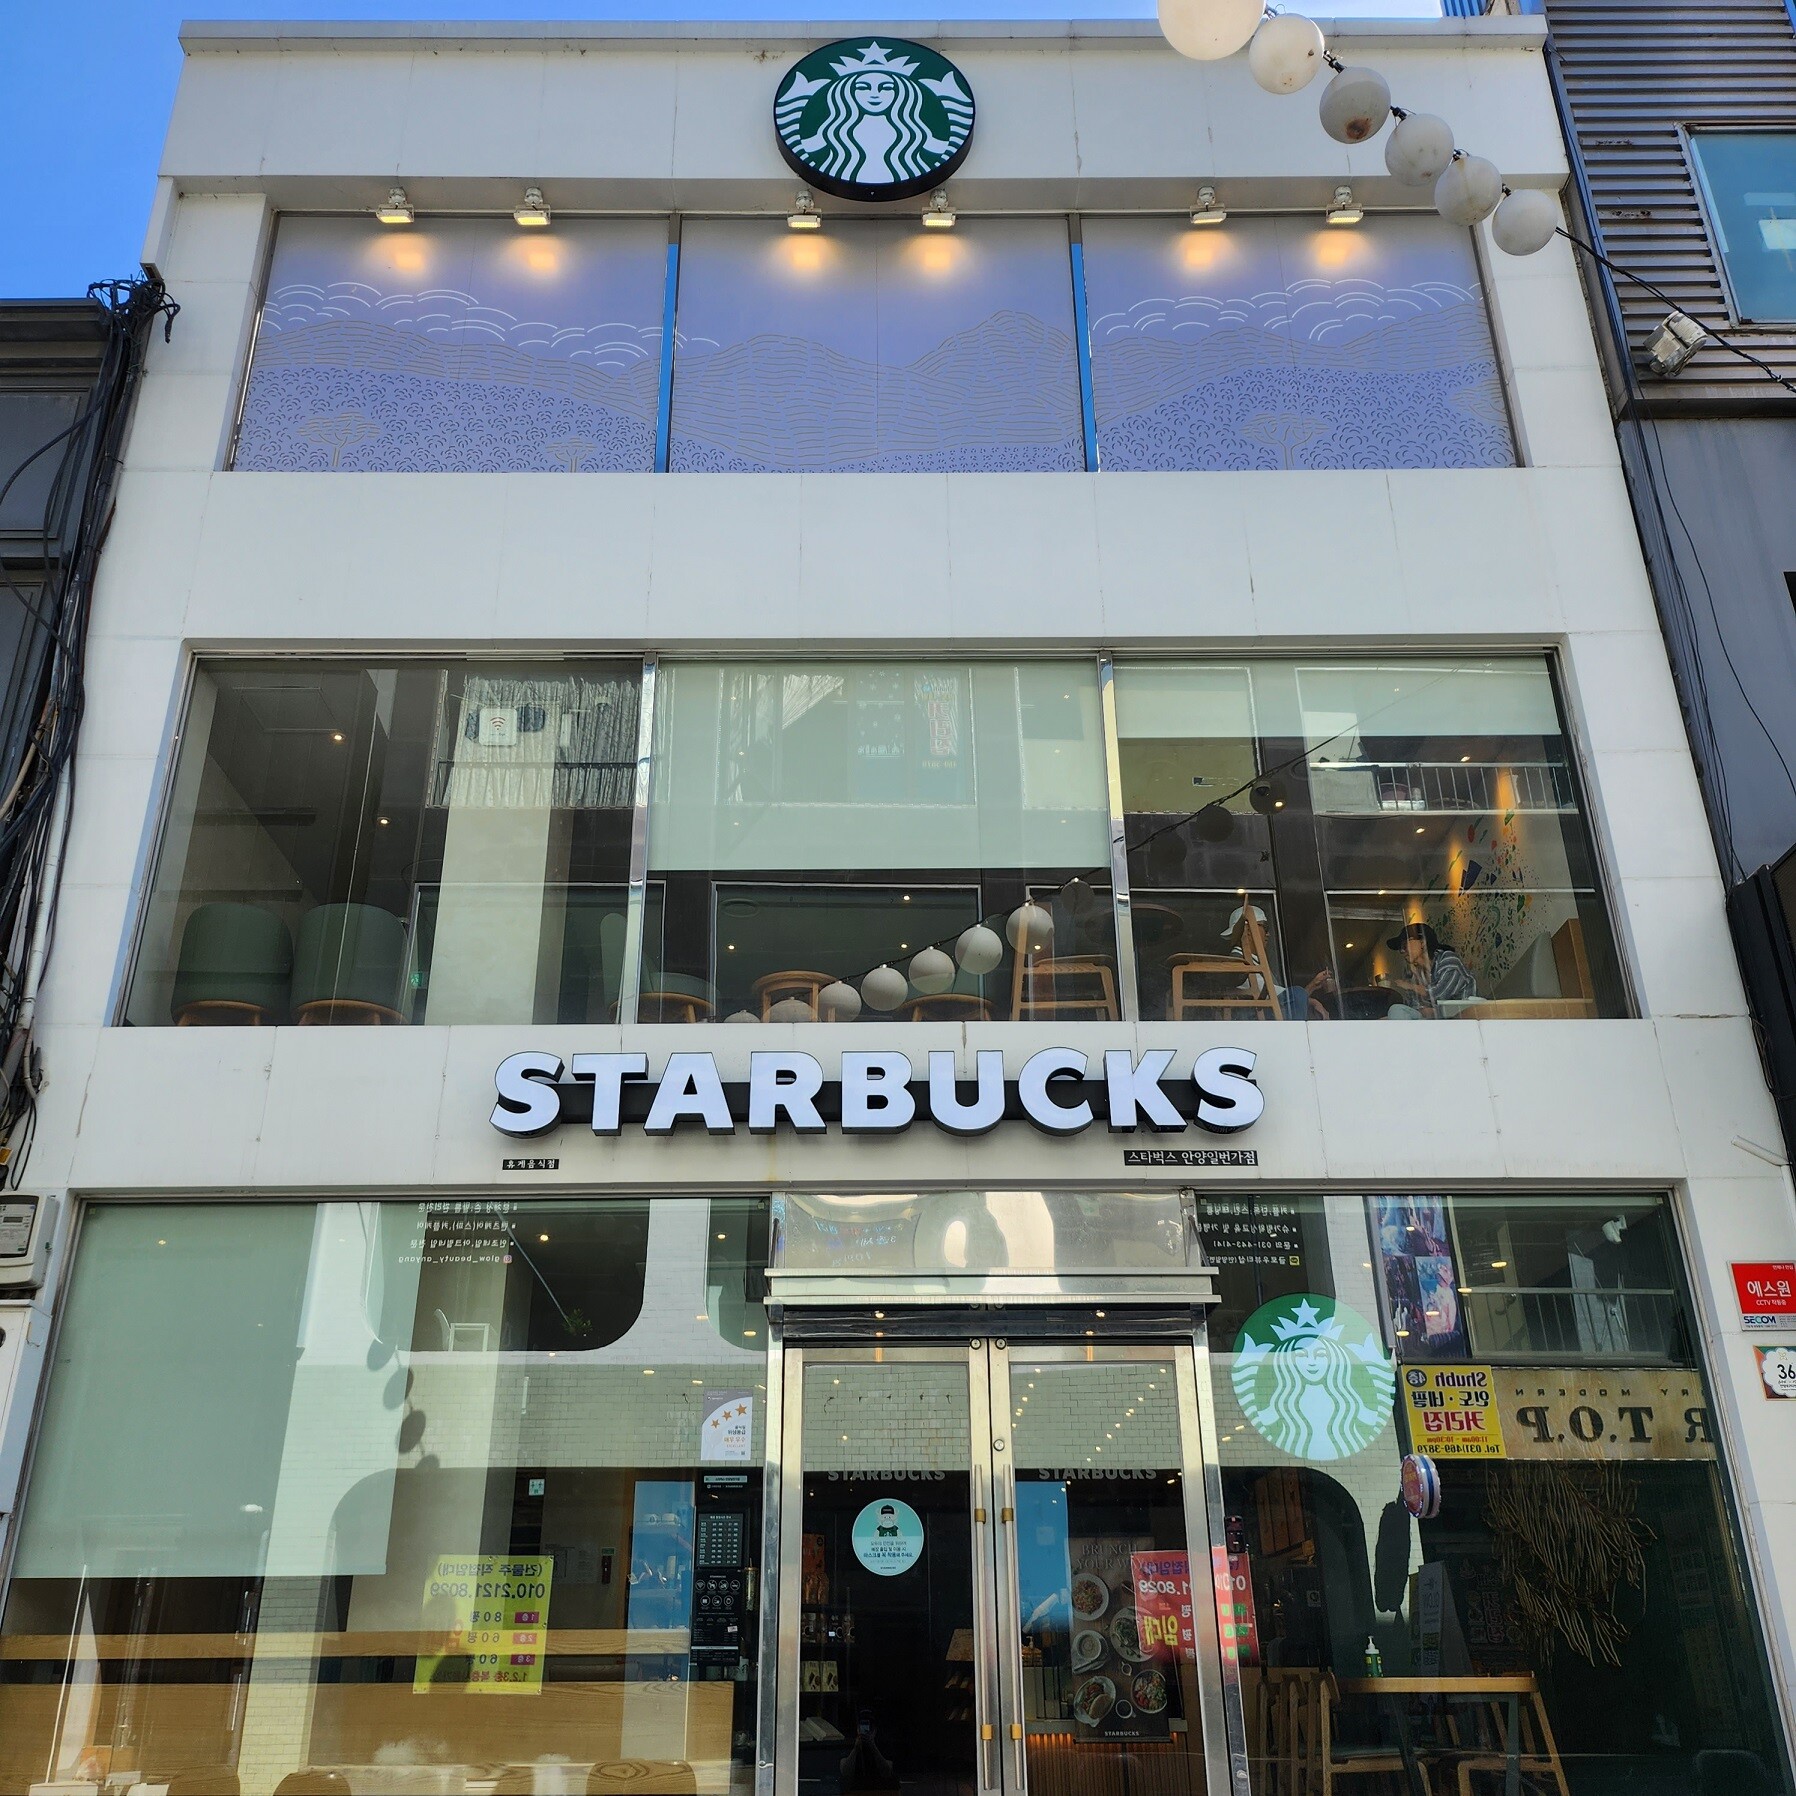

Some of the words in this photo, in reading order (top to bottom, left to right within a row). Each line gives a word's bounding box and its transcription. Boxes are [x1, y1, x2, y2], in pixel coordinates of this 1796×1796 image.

[489, 1046, 1266, 1136] STARBUCKS
[1127, 1150, 1179, 1165] 스타벅스
[1181, 1150, 1256, 1165] 안양일번가점
[506, 1159, 555, 1169] 휴게음식점
[1747, 1281, 1791, 1297] 에스원
[1743, 1315, 1777, 1324] SECOM
[828, 1469, 946, 1481] STARBUCKS
[1038, 1468, 1158, 1480] STARBUCKS
